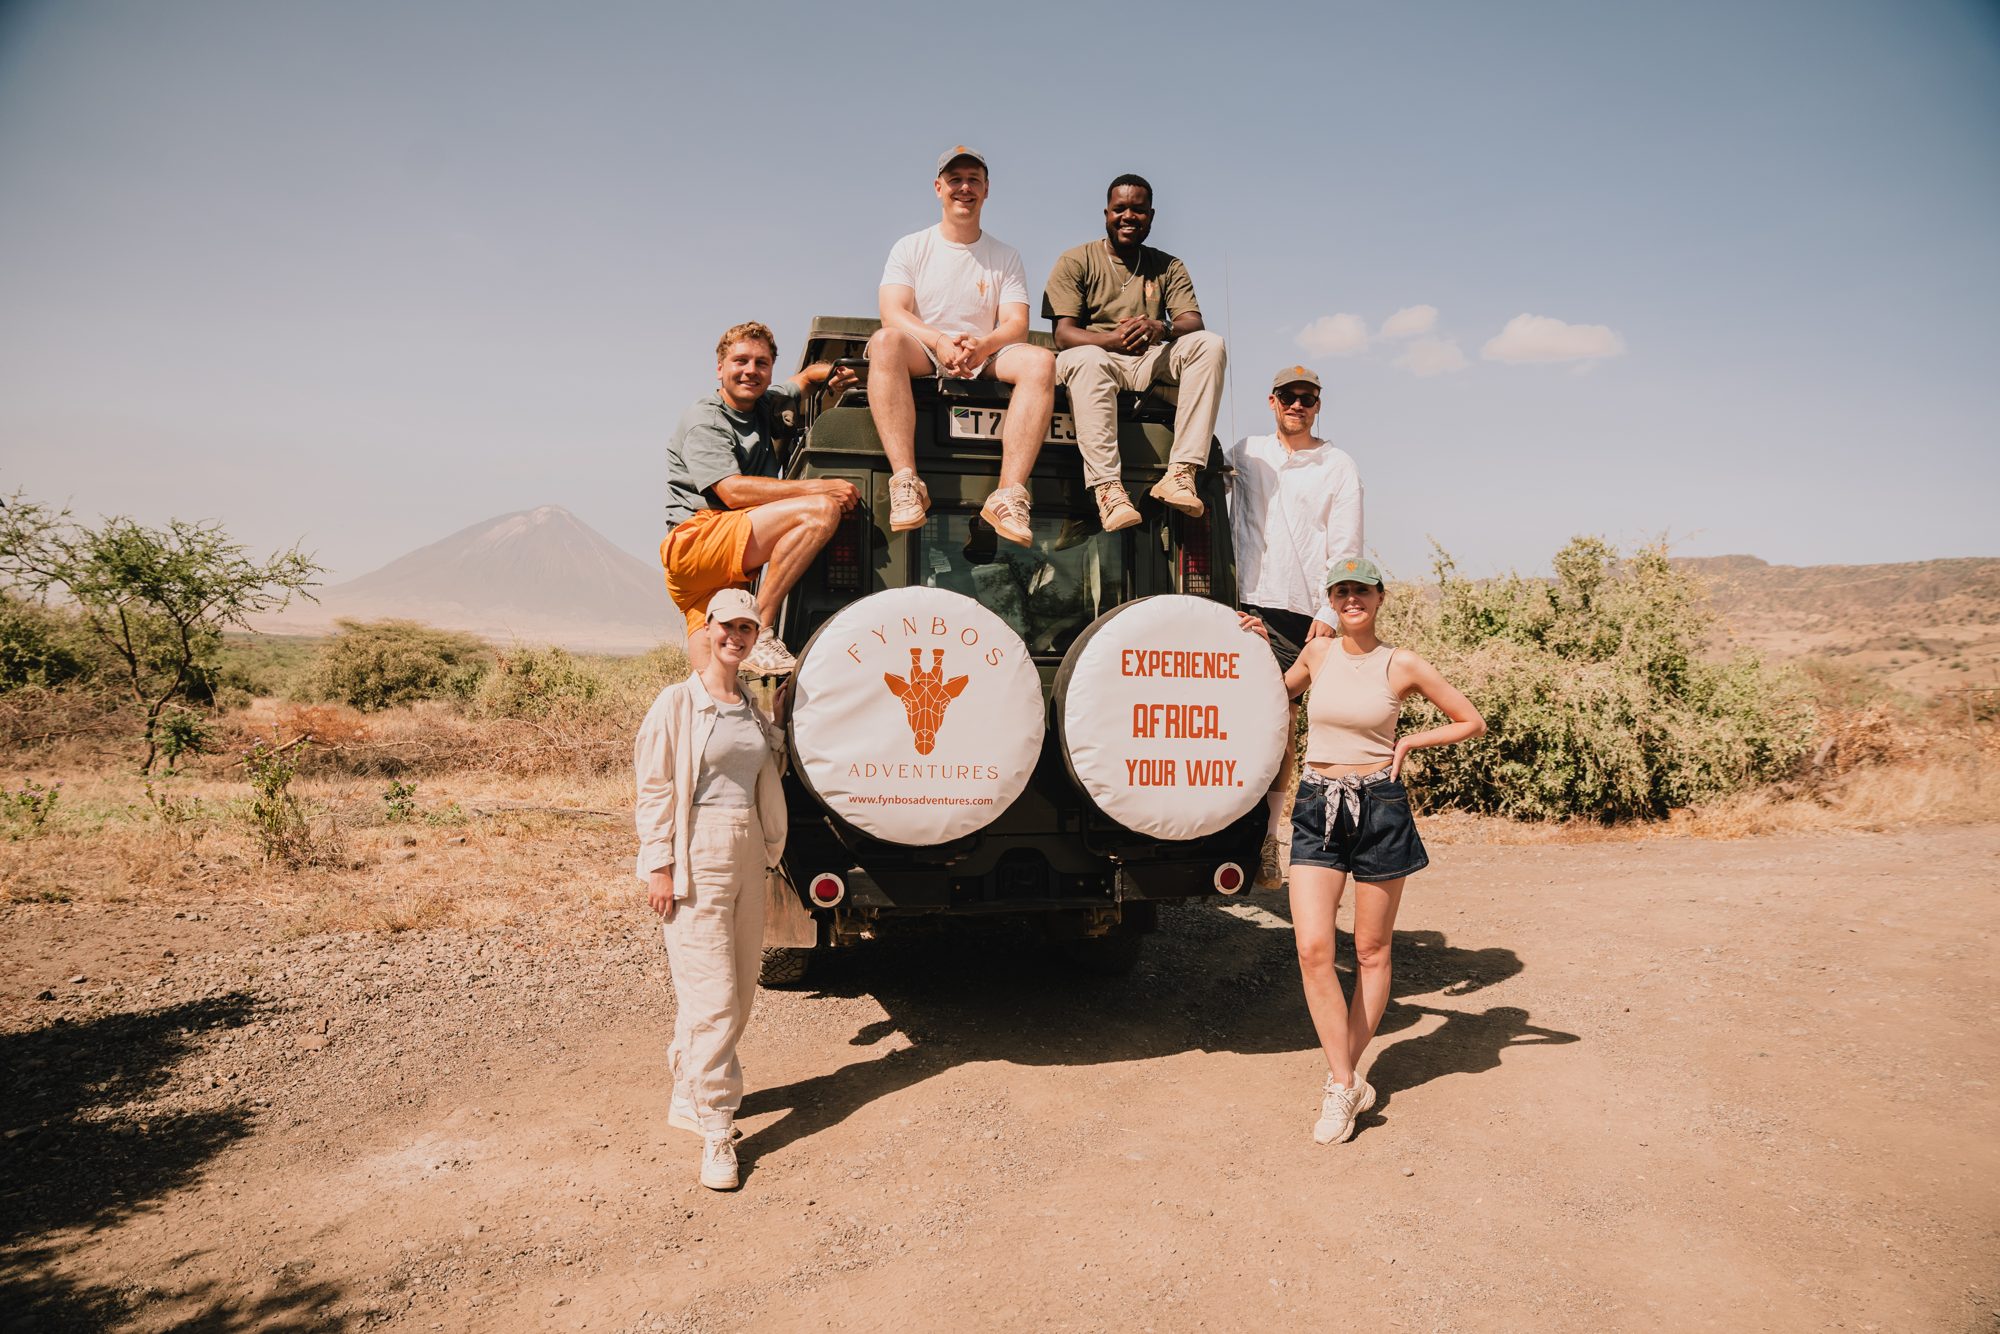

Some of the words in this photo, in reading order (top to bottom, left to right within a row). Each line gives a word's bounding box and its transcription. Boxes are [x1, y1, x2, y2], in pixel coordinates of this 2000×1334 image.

[847, 616, 1004, 667] FYNBOS
[1120, 649, 1240, 680] EXPERIENCE
[1131, 703, 1228, 741] AFRICA.
[847, 763, 999, 781] ADVENTURES
[1125, 758, 1176, 788] YOUR
[1185, 759, 1244, 788] WAY.
[848, 794, 993, 806] www.fynbosadventures.com
